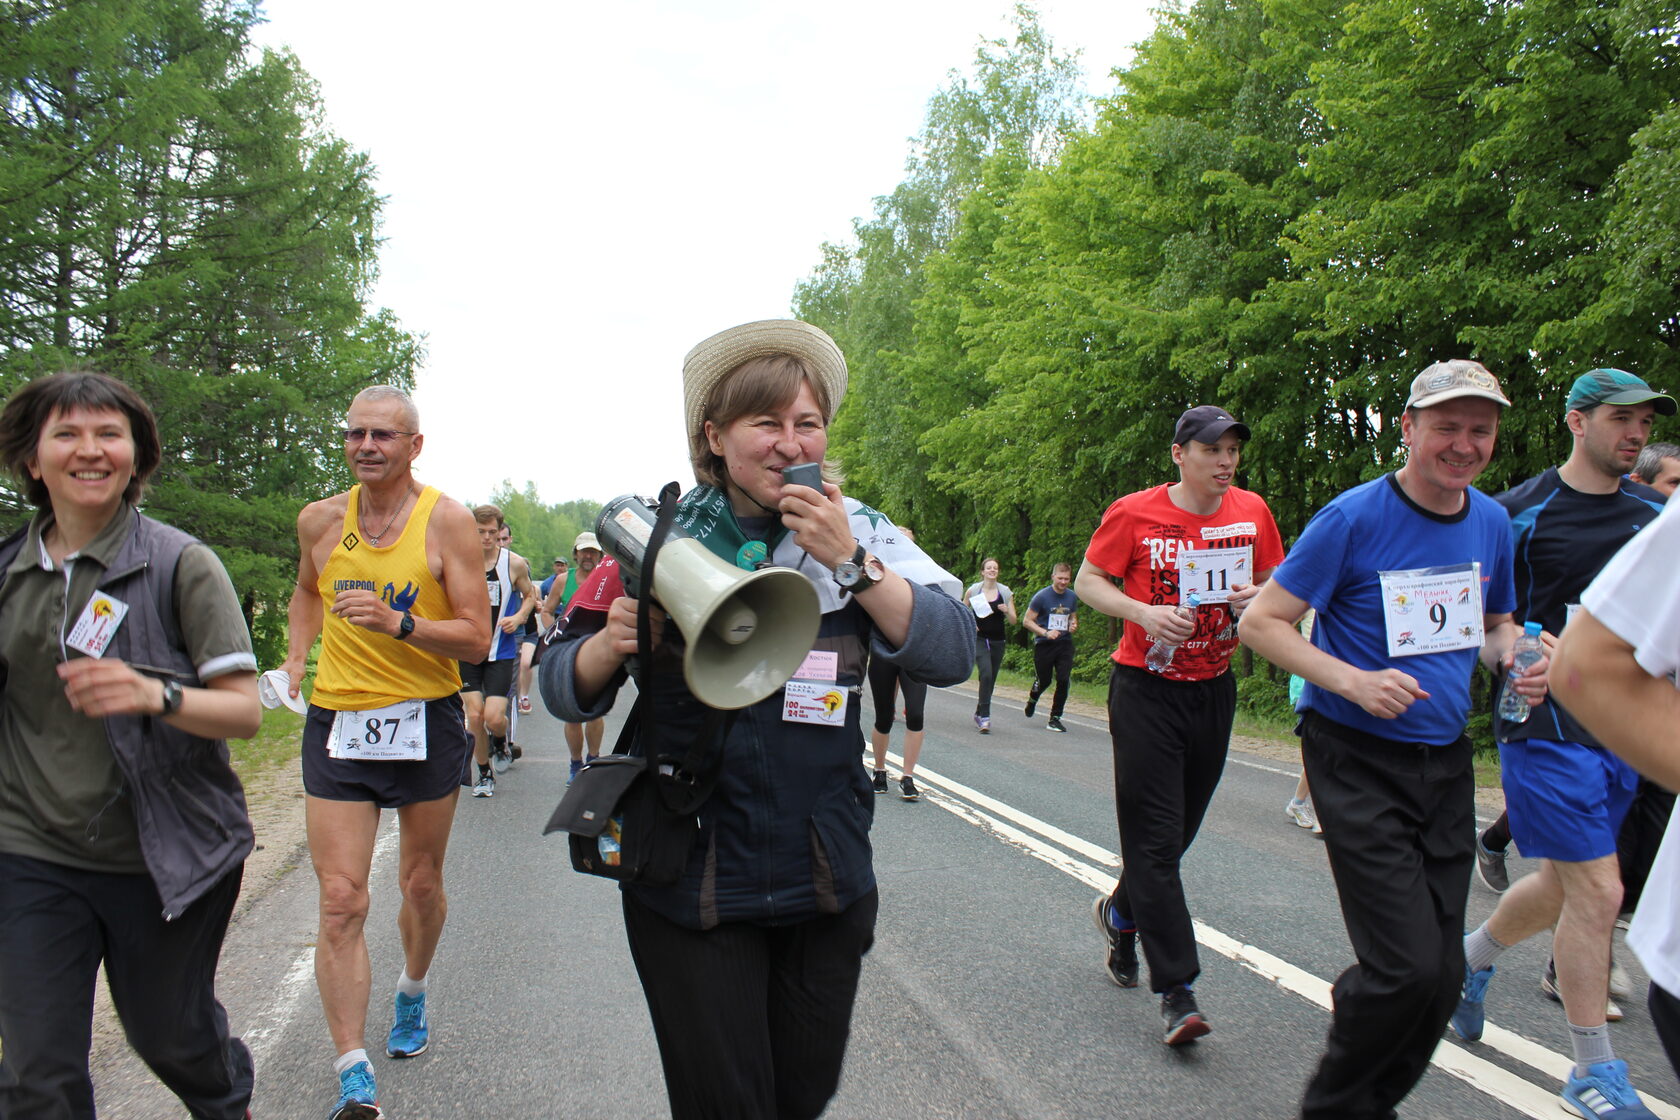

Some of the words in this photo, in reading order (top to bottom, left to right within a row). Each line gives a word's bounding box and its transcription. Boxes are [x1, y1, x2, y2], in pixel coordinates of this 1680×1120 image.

[334, 580, 377, 592] LIVERPOOL
[1205, 568, 1229, 591] 11
[1429, 603, 1447, 635] 9
[1187, 641, 1209, 649] CITY
[785, 701, 799, 709] 100
[365, 717, 401, 745] 87
